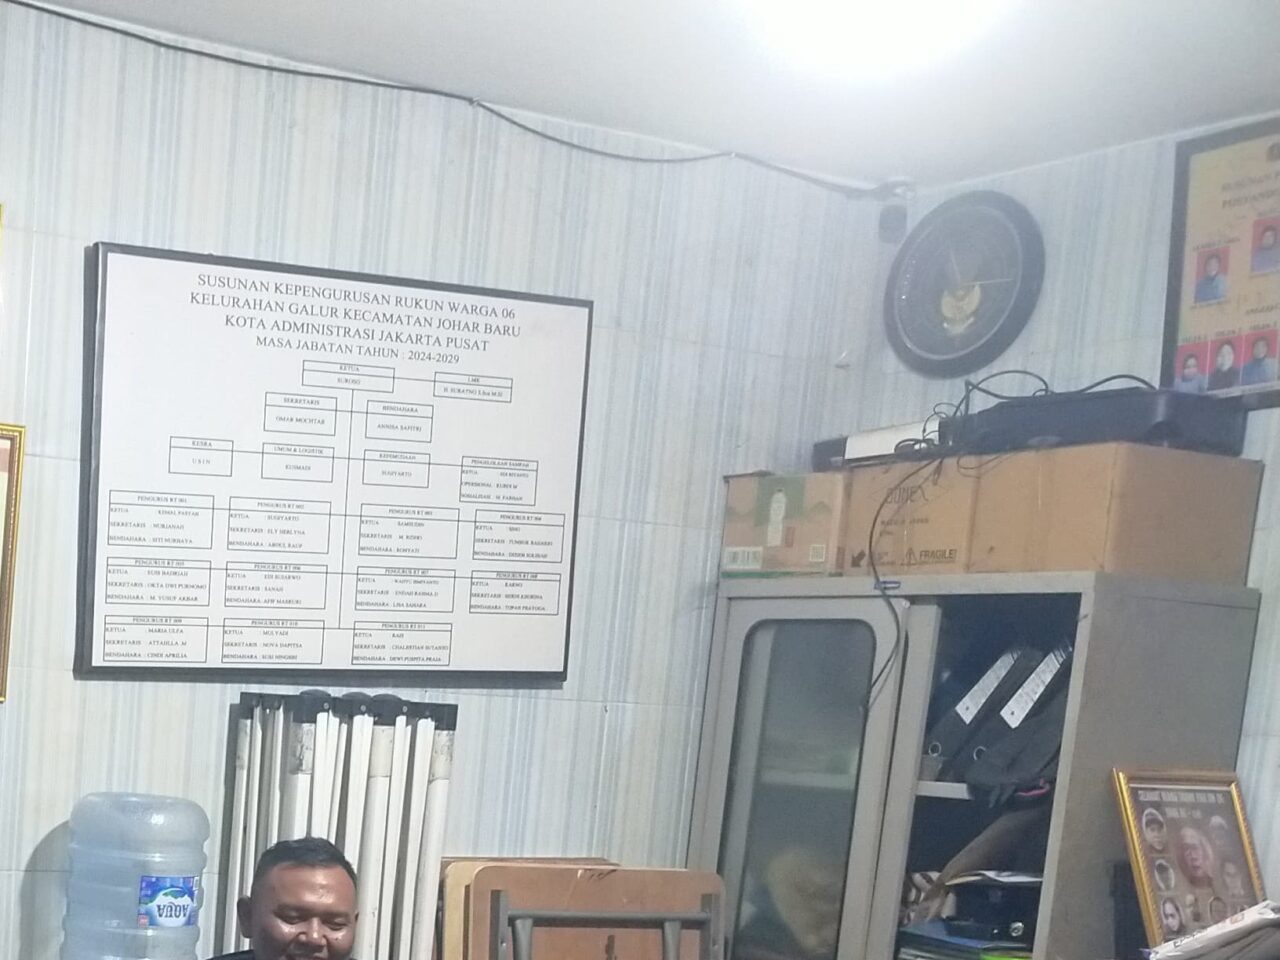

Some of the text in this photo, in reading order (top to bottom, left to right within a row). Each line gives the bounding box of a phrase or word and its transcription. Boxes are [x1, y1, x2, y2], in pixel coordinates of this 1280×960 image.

[197, 273, 515, 319] SUSUNAN KEPENGURUSAN RUKUN WARGA 06
[190, 291, 521, 337] KELURAHAN GALUR KECAMATAN JOHAR BARU
[224, 314, 489, 351] KOTA ADMINISTRASI JAKARTA PUSAT
[255, 335, 459, 364] MASA JABATAN TAHUN 2024-2029
[283, 397, 319, 405] SEKRETARIS
[382, 405, 418, 413] BENDAHARA
[109, 534, 146, 542] BENDAHARA
[156, 902, 189, 919] AQUA
